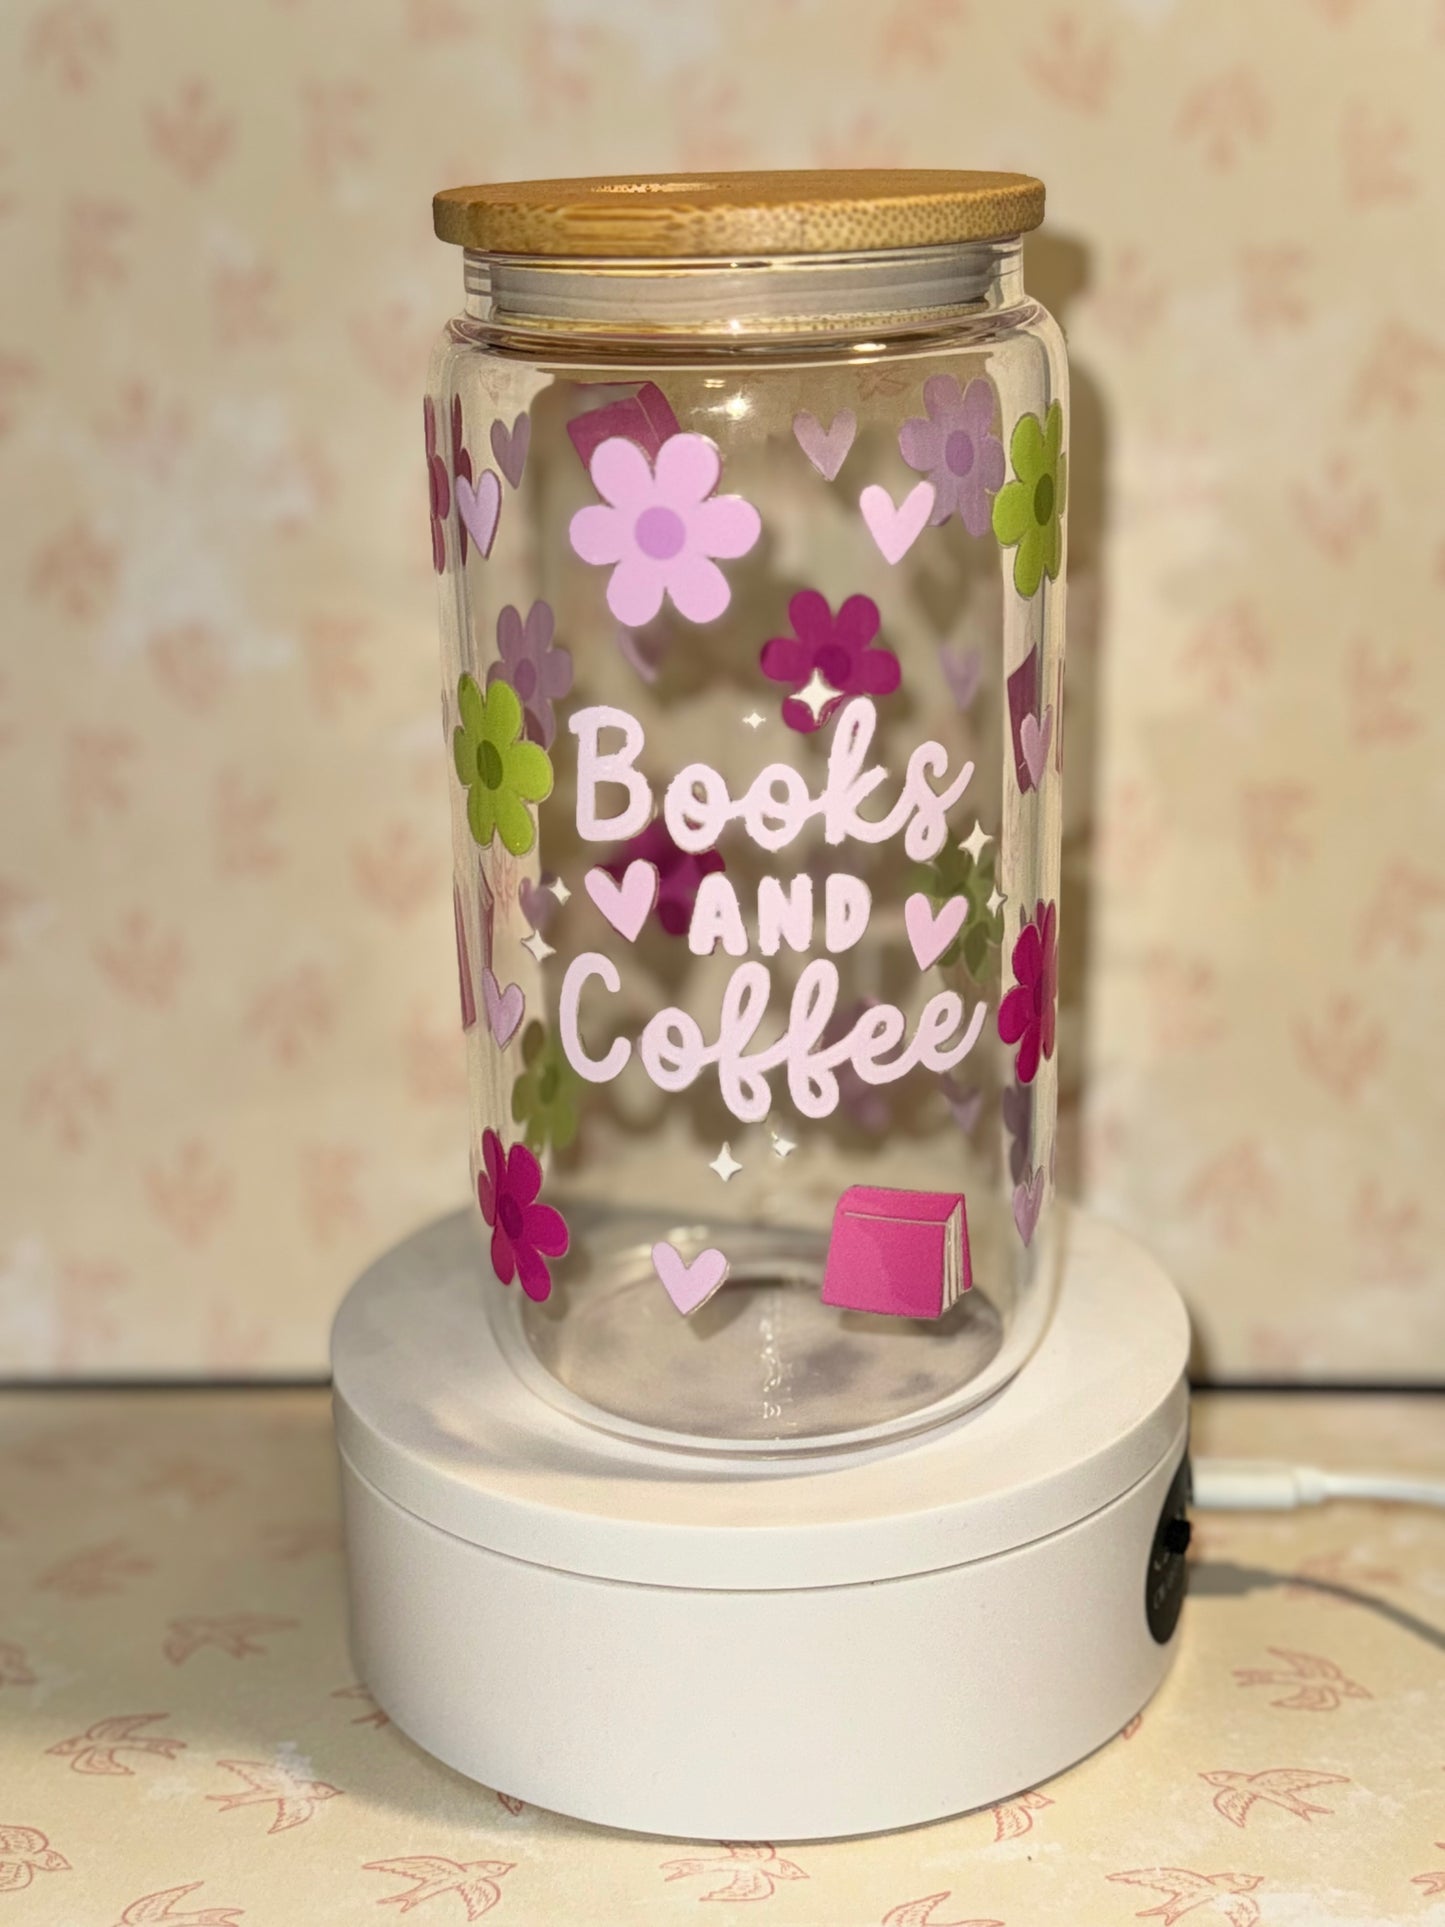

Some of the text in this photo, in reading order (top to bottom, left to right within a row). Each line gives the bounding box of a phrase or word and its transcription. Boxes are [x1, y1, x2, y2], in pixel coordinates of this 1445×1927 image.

[568, 696, 975, 862] Books
[688, 872, 872, 956] AND
[559, 951, 988, 1123] Coffee
